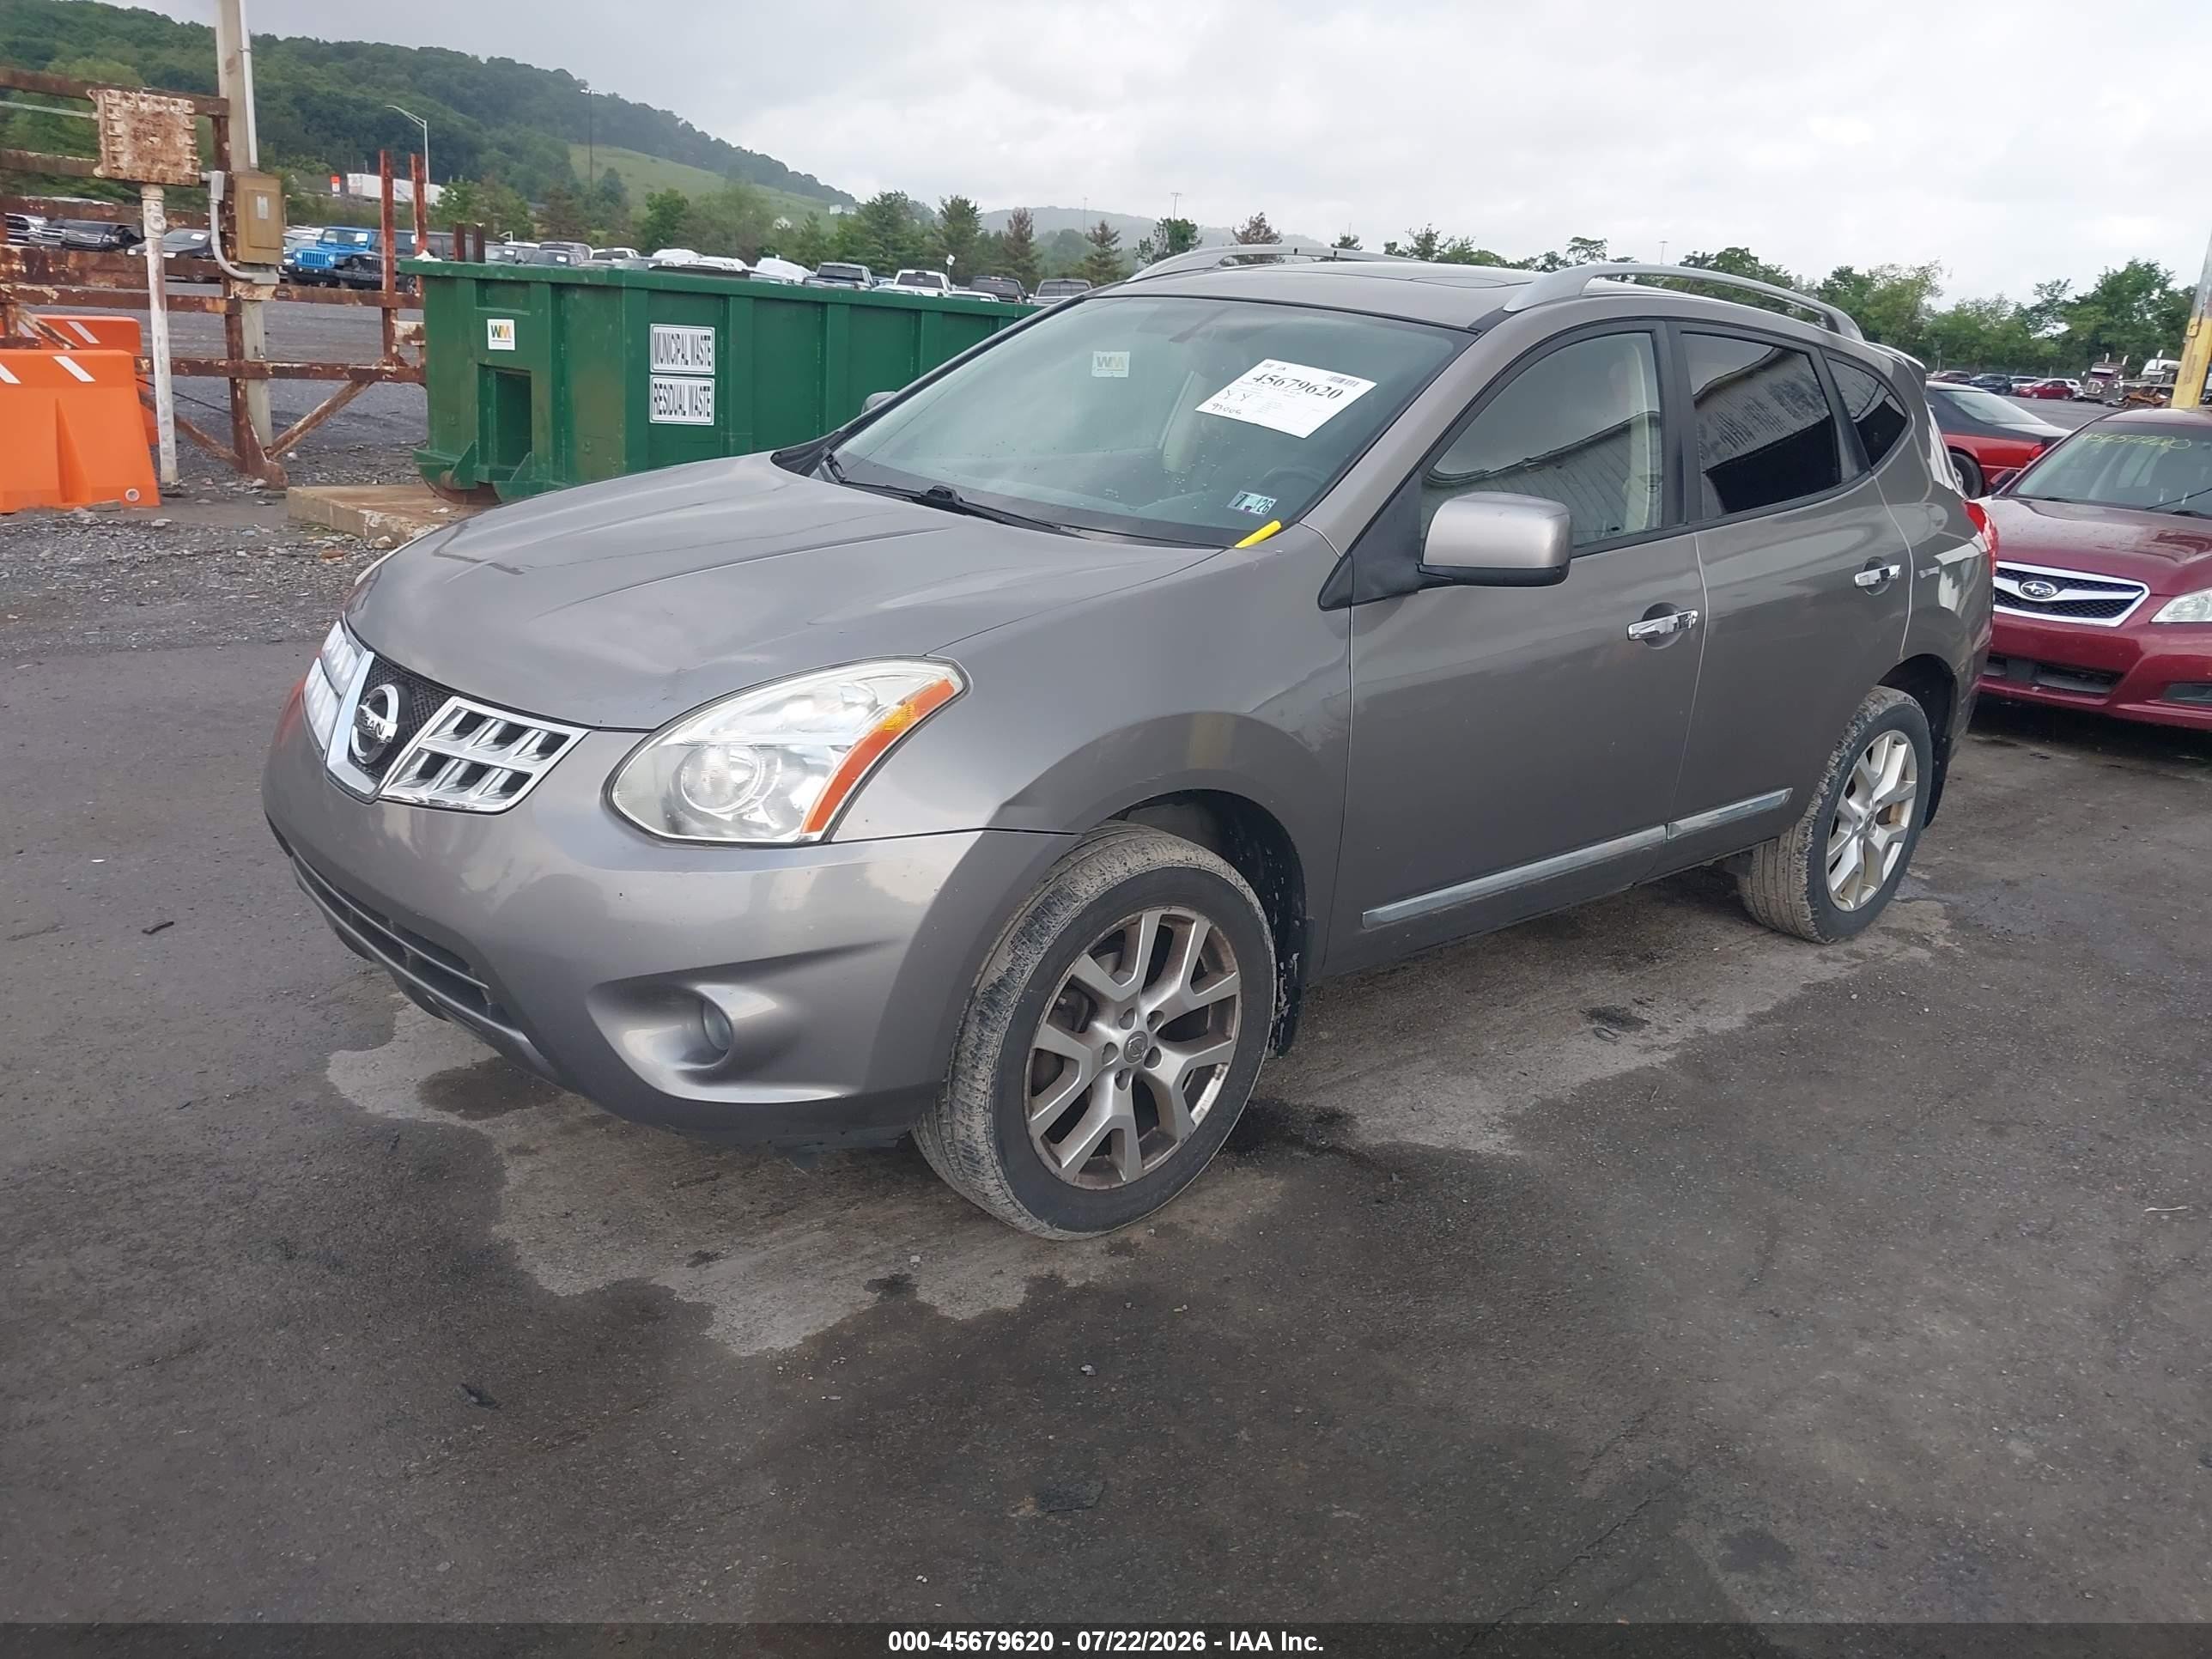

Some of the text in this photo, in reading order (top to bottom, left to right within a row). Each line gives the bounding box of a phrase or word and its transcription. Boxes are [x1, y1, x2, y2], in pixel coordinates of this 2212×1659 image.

[490, 325, 511, 338] WM
[654, 332, 711, 367] MUNICIPAL WASTE
[654, 383, 711, 417] RESIDUAL WASTE
[1253, 373, 1344, 399] 45679620
